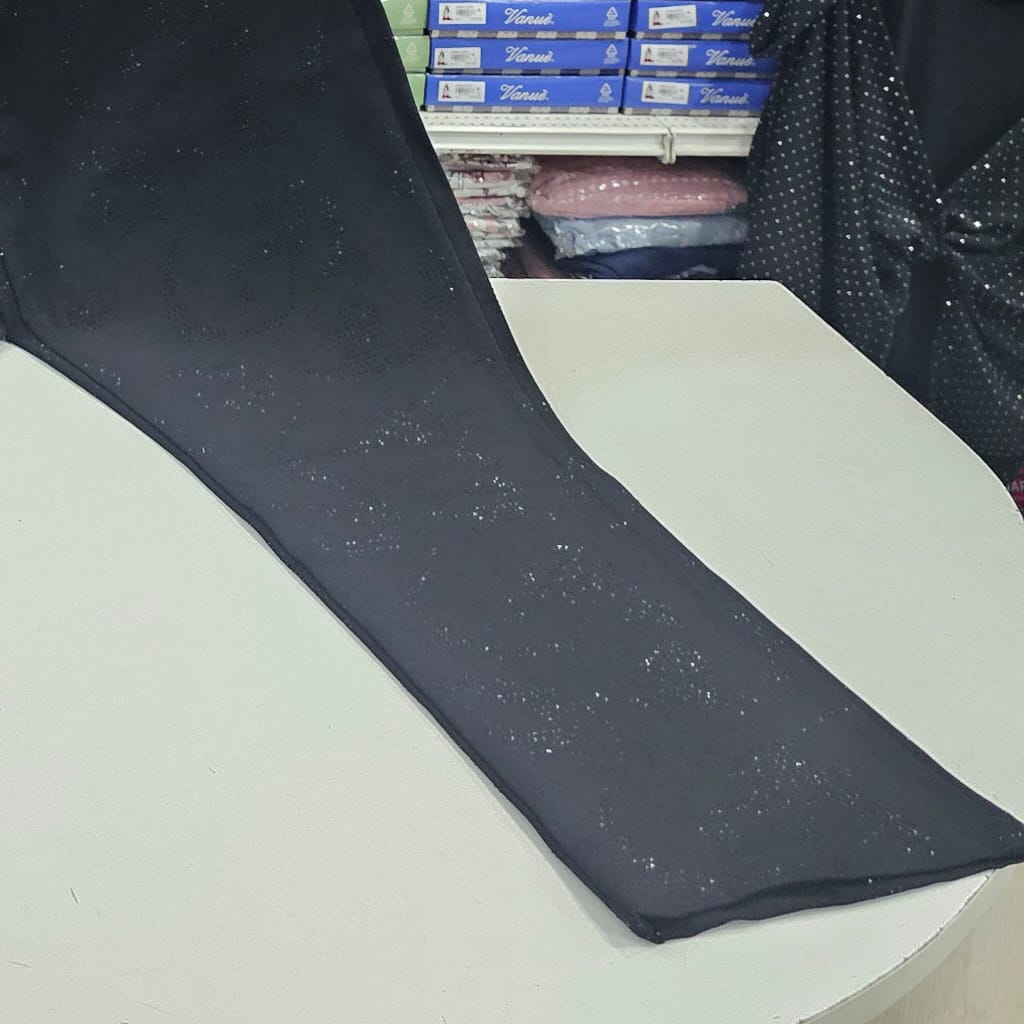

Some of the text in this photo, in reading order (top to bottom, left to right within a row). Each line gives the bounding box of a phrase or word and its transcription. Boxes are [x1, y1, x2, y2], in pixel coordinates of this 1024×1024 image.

[504, 8, 553, 25] Vanuè
[506, 46, 554, 63] Vanuè
[500, 84, 548, 101] Vanuè
[700, 87, 749, 105] Vanuè
